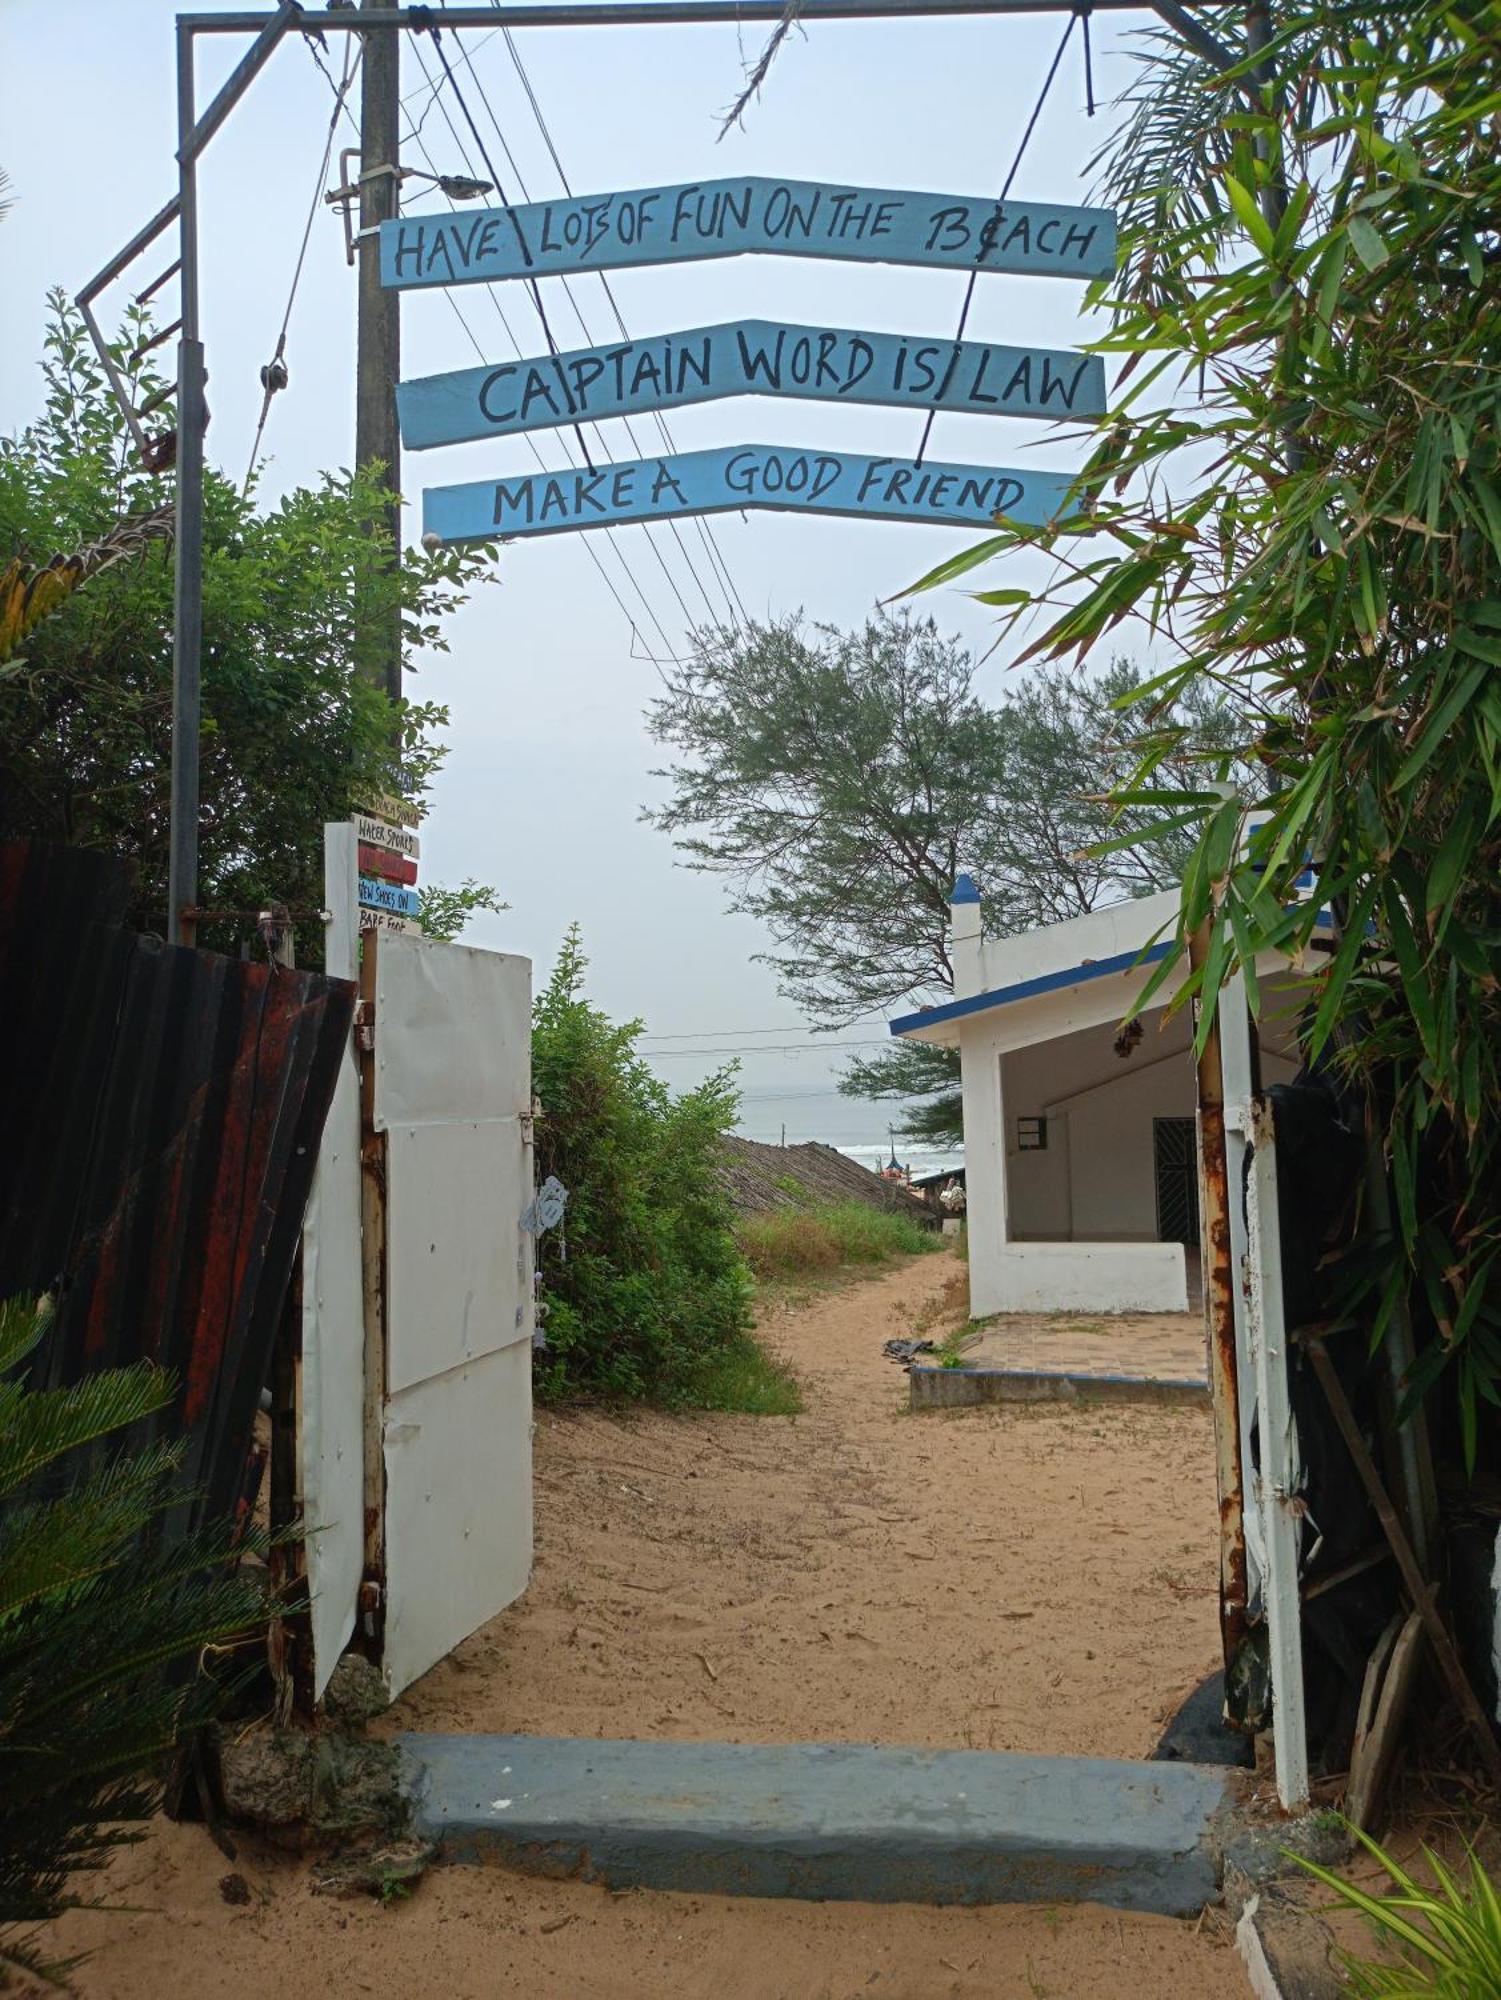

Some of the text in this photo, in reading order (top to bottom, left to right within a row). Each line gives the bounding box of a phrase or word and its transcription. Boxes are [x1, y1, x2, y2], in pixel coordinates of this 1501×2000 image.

[395, 216, 501, 279] HAVE
[616, 194, 661, 245] OF
[670, 186, 753, 243] FUN
[764, 187, 821, 239] ON
[827, 193, 905, 240] THE
[925, 202, 1098, 259] BEACH
[736, 329, 874, 394] WORD
[968, 349, 1089, 409] LAW
[492, 452, 1025, 525] MAKE A GOOD FRIEND
